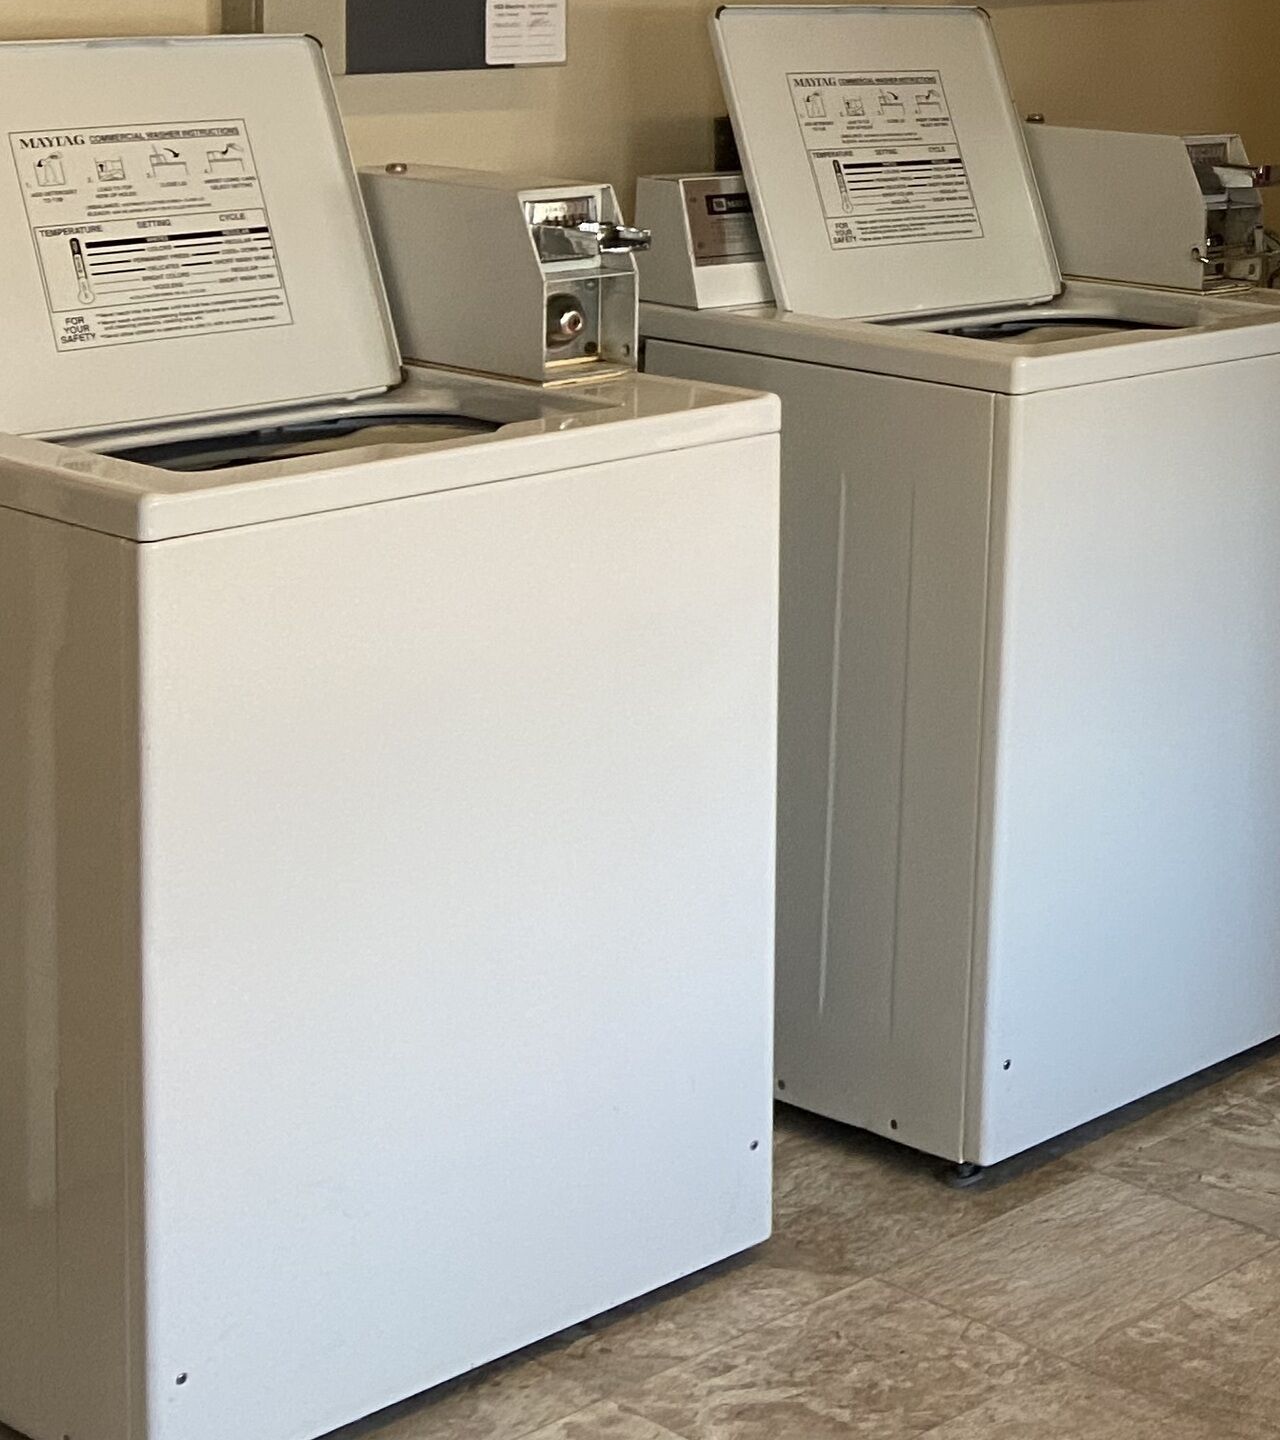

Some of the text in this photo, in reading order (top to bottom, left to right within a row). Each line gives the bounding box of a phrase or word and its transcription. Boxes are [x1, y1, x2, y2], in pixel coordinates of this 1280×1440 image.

[793, 77, 836, 87] MAYTAG
[89, 132, 145, 145] COMMERCIAL
[182, 127, 240, 139] INSTRUCTIONS
[20, 135, 85, 149] MAYTAG
[219, 213, 246, 222] CYCLE
[137, 219, 171, 229] SETTING
[39, 224, 103, 238] TEMPERATURE
[833, 236, 857, 244] SAFETY
[65, 317, 84, 325] FOR
[64, 324, 89, 334] YOUR
[61, 333, 96, 344] SAFETY
